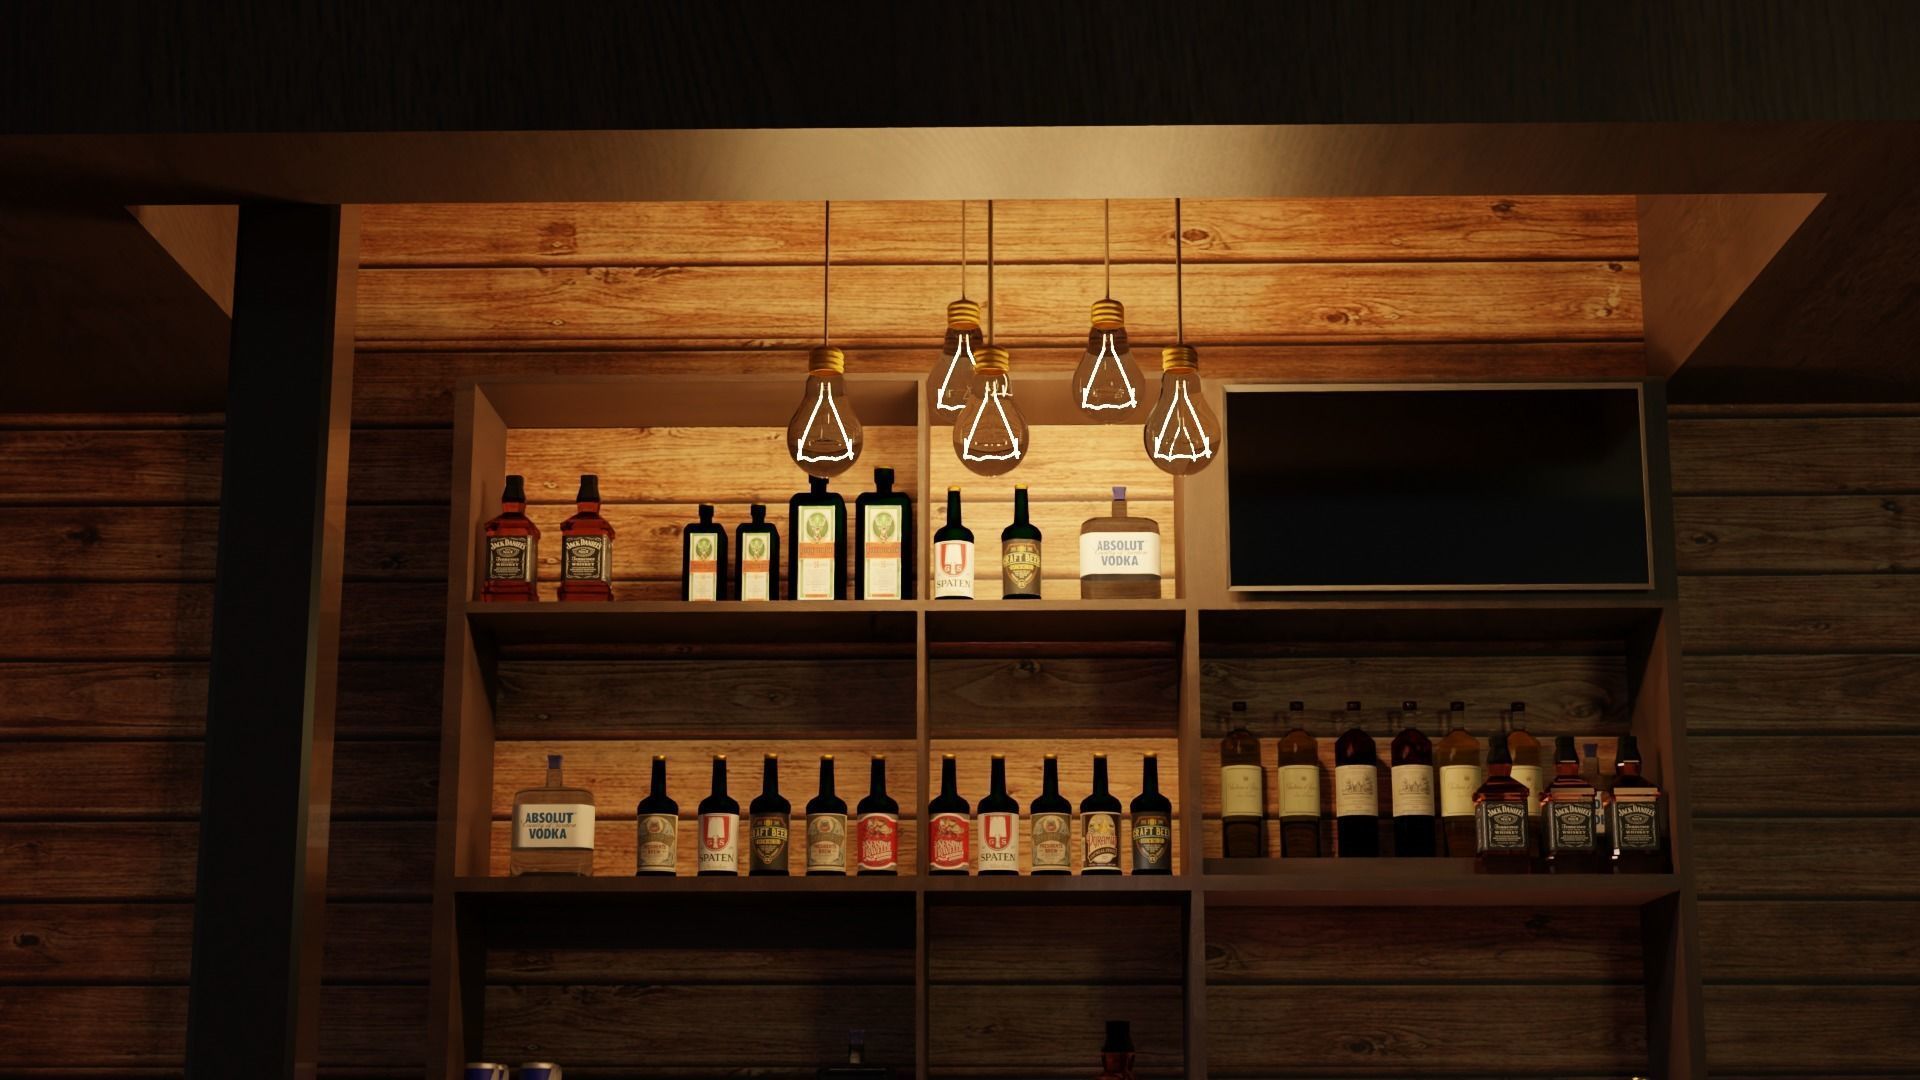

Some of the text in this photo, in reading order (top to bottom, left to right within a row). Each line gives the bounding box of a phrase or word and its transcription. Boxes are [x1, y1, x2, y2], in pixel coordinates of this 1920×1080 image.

[490, 541, 504, 550] JACK
[565, 540, 580, 550] JACK
[1097, 540, 1145, 551] ABSOLUT
[1101, 555, 1139, 567] VODKA
[936, 579, 970, 589] SPATEN
[1487, 808, 1502, 817] JACK
[1554, 807, 1569, 817] JACK
[1618, 807, 1633, 817] JACK
[525, 812, 574, 824] ABSOLUT
[529, 828, 567, 839] VODKA
[700, 853, 734, 862] SPATEN
[980, 853, 1016, 861] SPATEN
